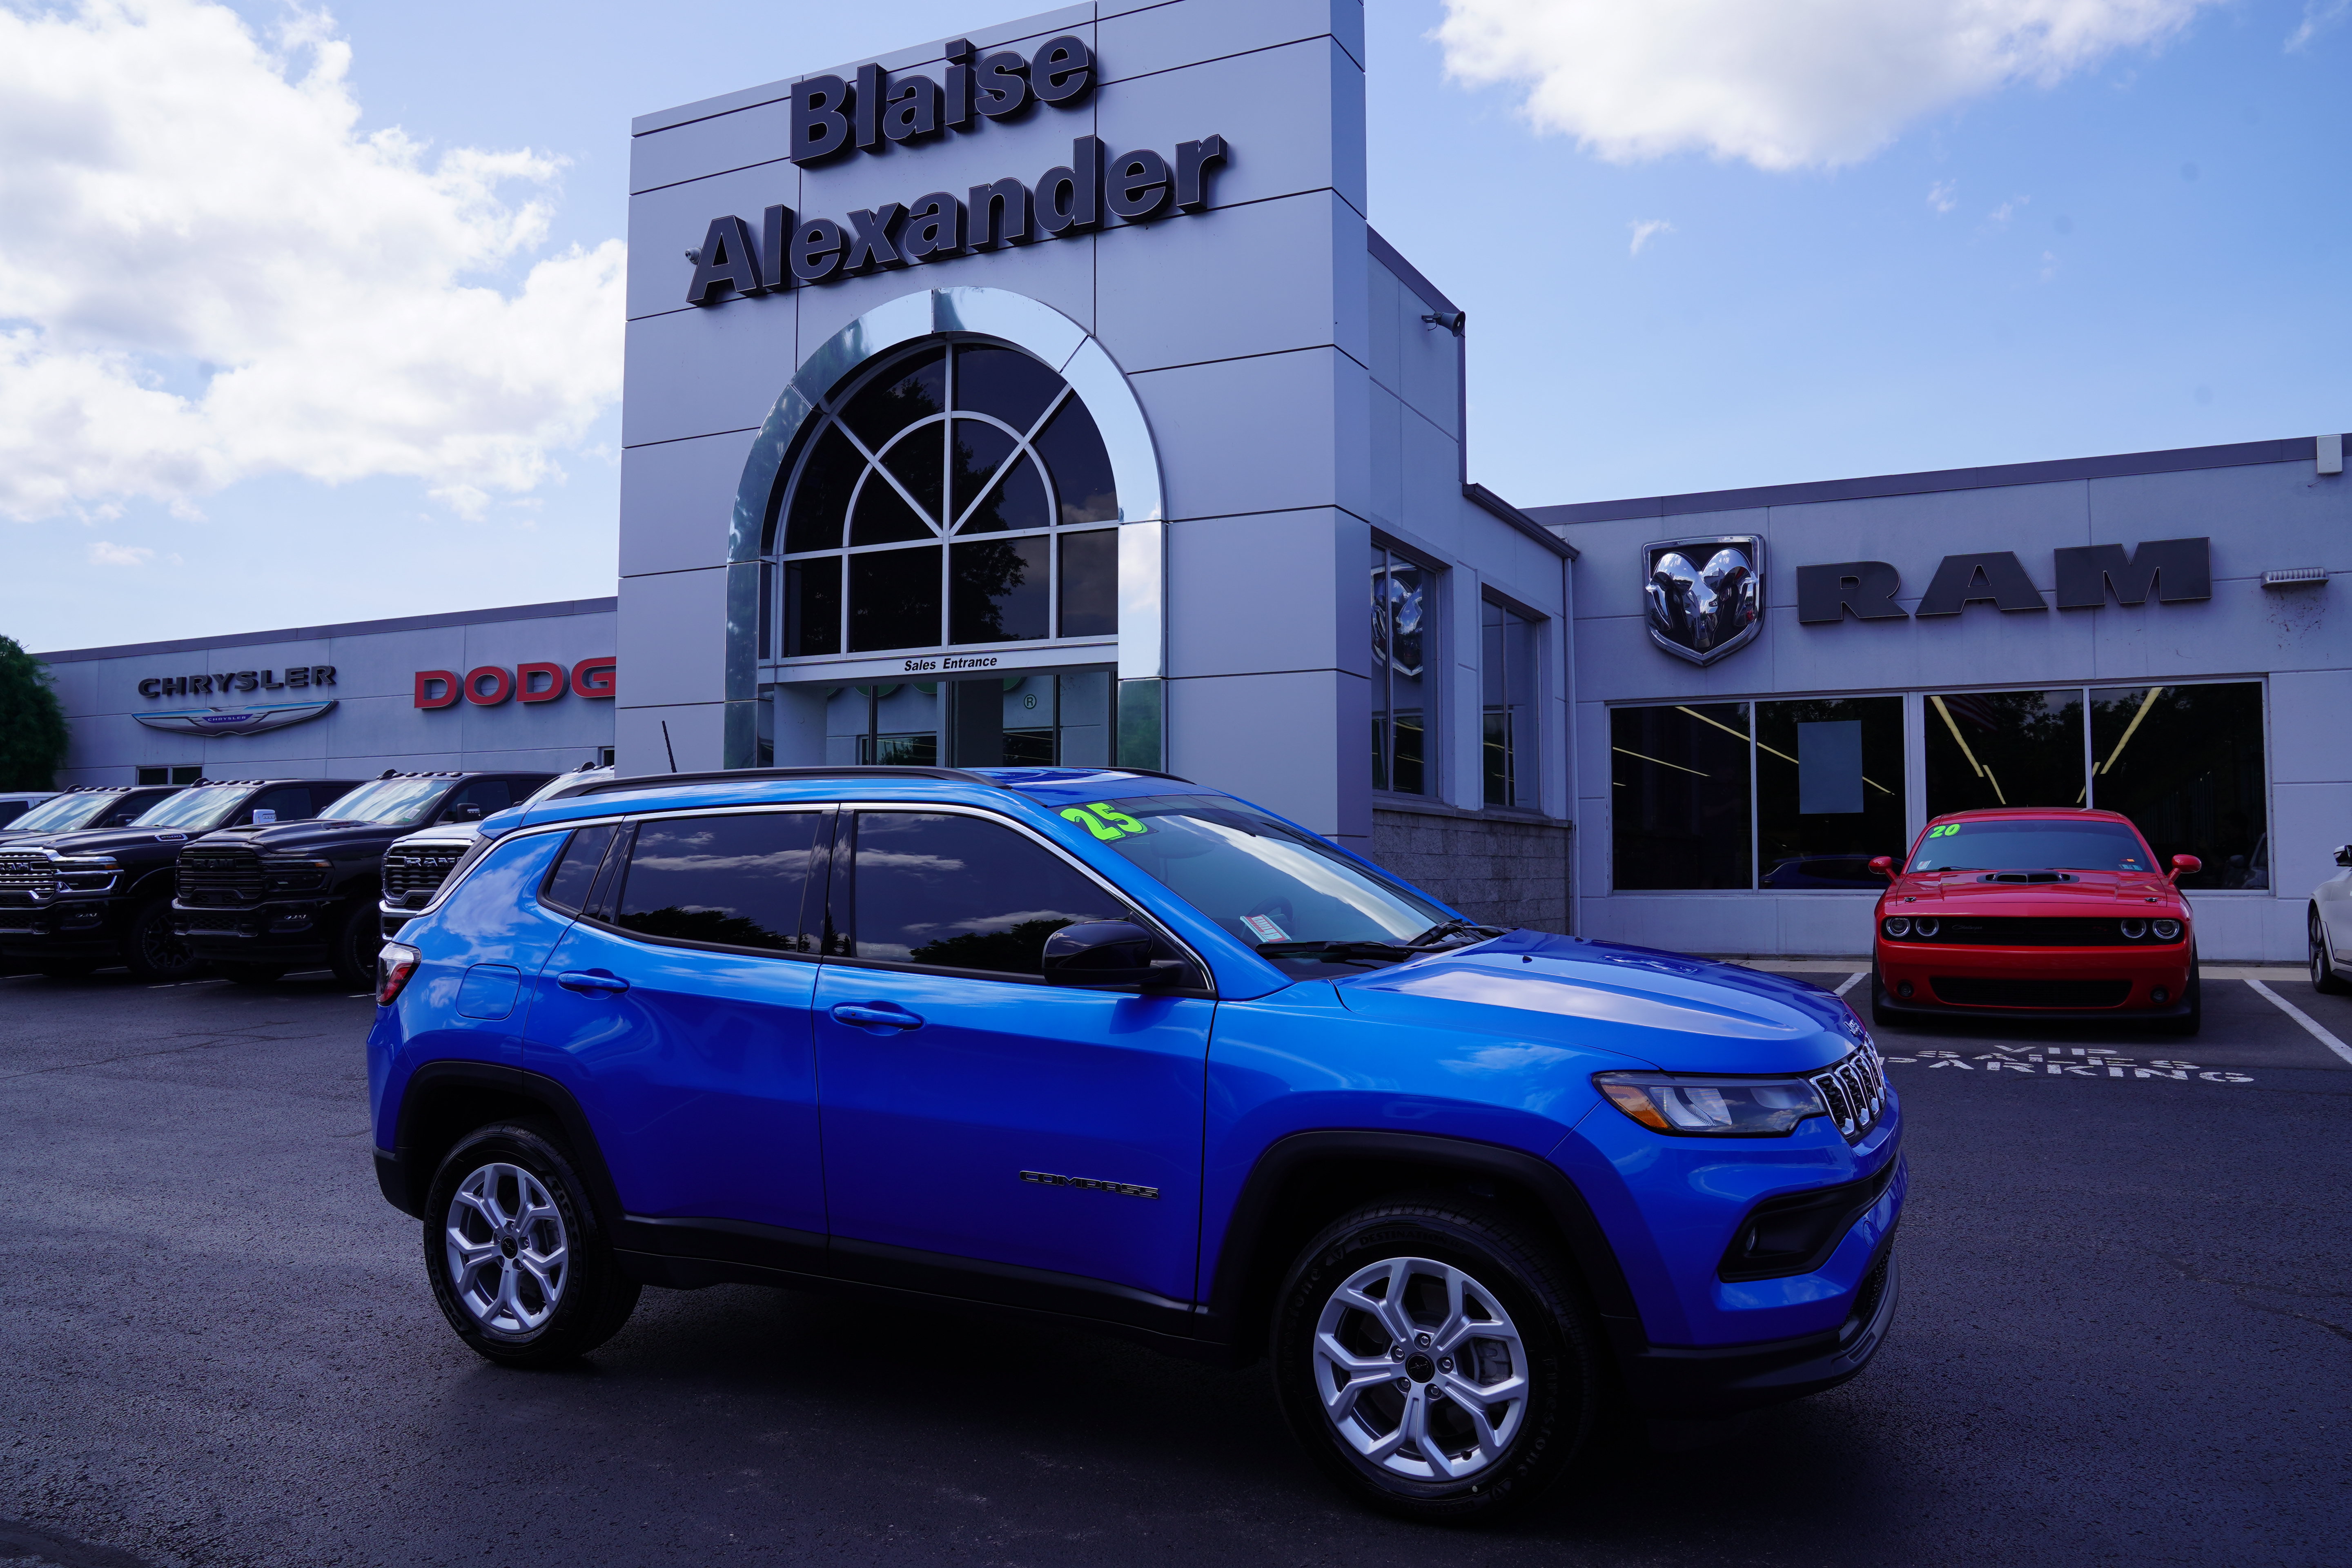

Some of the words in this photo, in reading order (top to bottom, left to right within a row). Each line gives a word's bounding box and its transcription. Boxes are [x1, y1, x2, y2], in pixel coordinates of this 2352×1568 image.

[791, 35, 1095, 167] Blaise
[686, 134, 1226, 306] Alexander
[1796, 537, 2212, 622] RAM
[904, 659, 936, 671] Sales
[943, 657, 997, 669] Entrance
[138, 665, 336, 697] CHRYSLER
[1060, 802, 1148, 840] 25
[1929, 824, 1960, 838] 20
[193, 859, 235, 869] RAM
[405, 858, 455, 868] RAM
[1878, 1056, 2254, 1082] PARKING
[1019, 1170, 1158, 1199] COMPASS
[1359, 1230, 1448, 1246] DESTINATION
